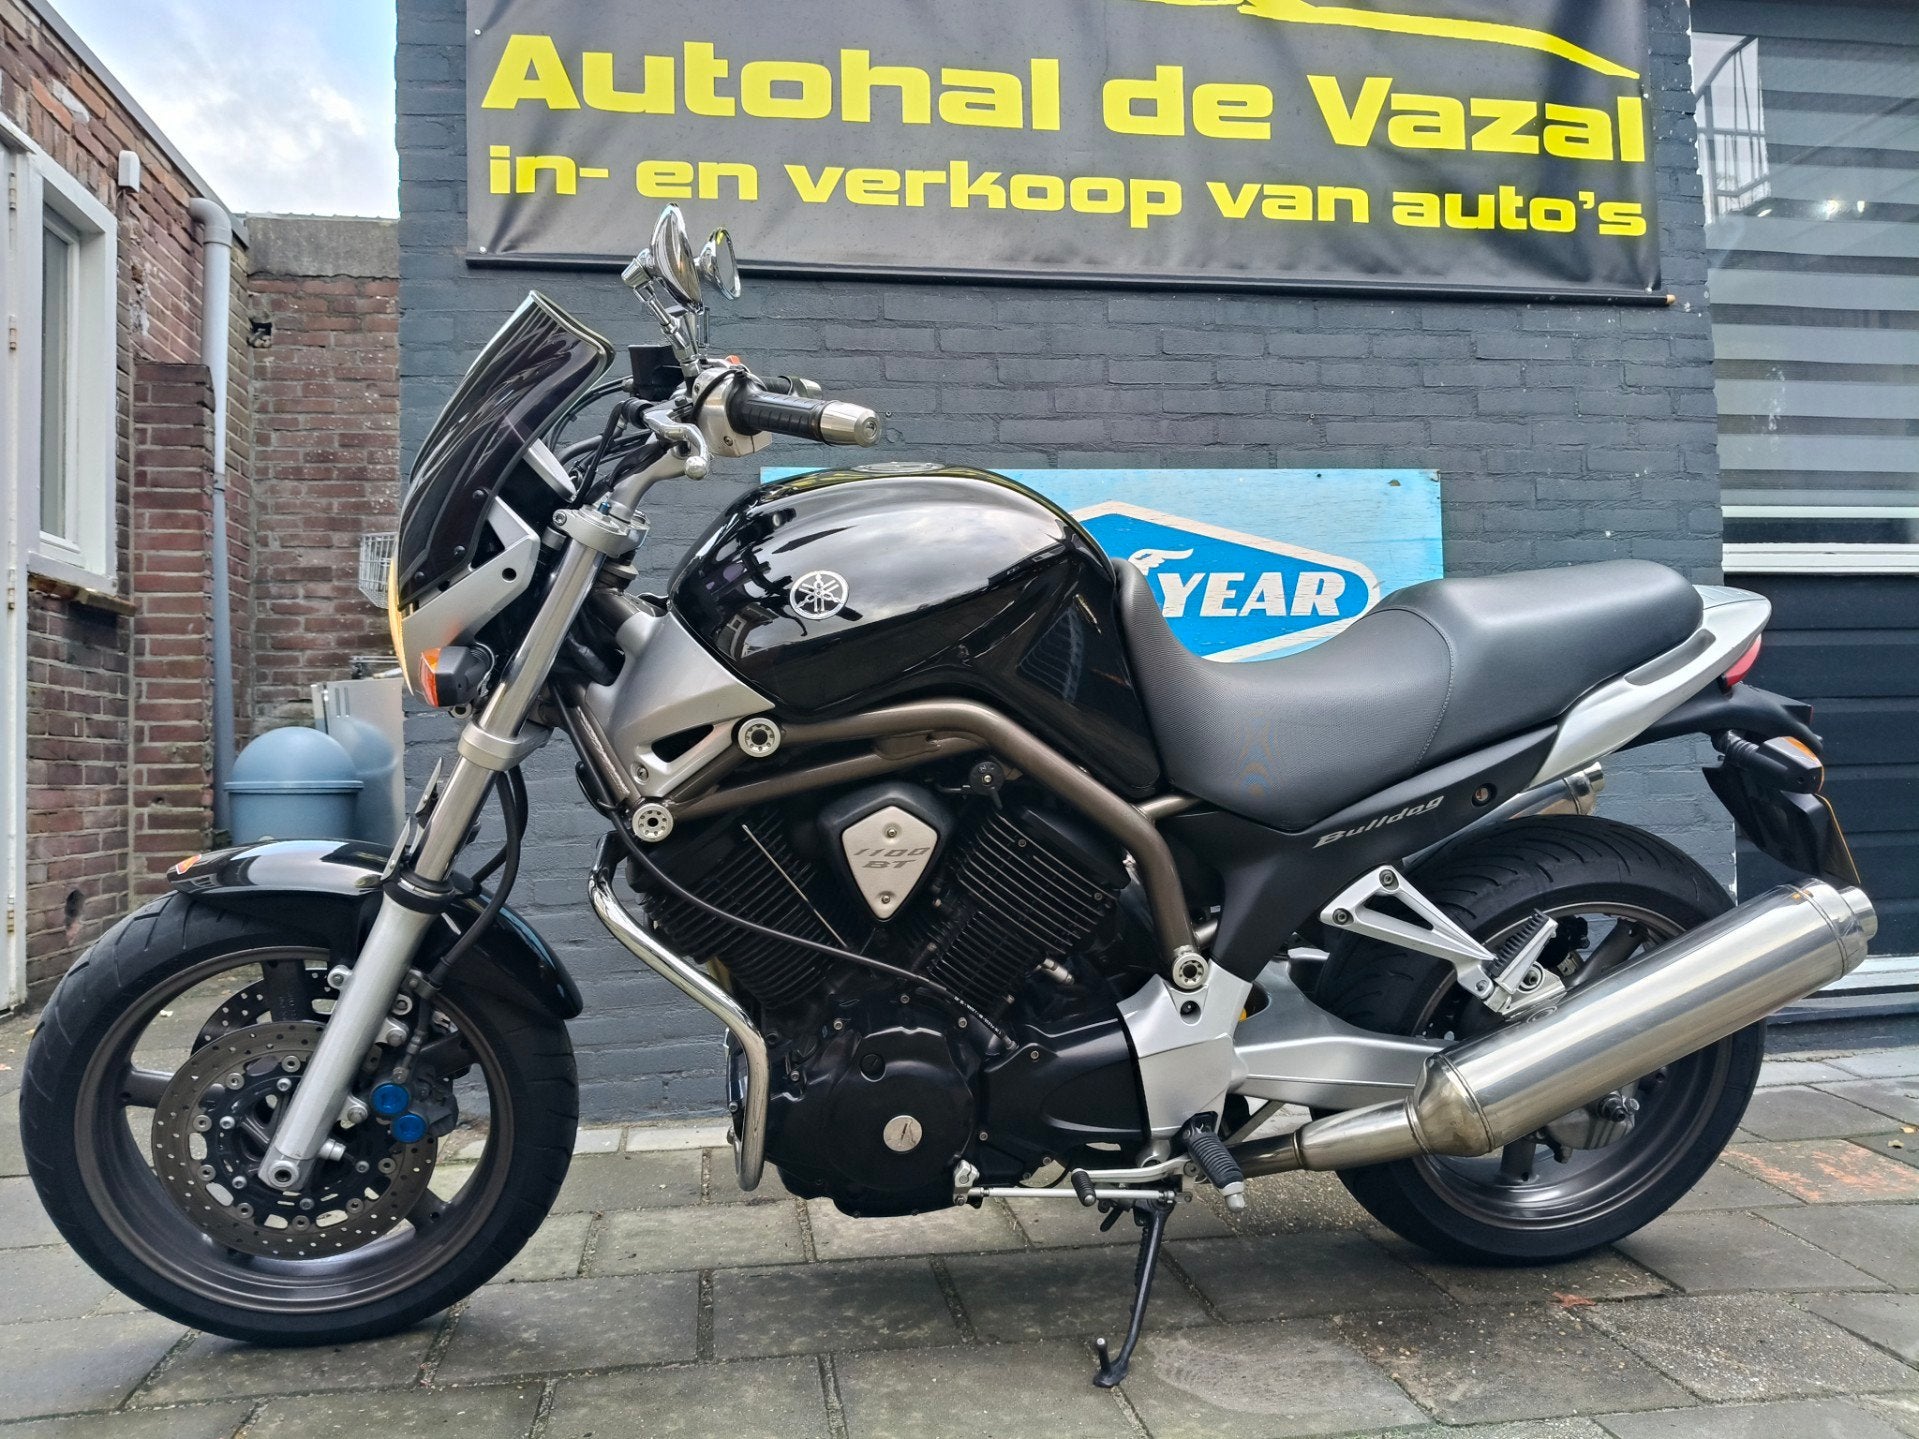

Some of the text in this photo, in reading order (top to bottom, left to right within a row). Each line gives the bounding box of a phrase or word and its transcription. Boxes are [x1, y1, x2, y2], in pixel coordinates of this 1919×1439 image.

[481, 34, 1647, 164] Autohal de Vazal
[489, 145, 1649, 238] in- en verkoop van auto's
[1311, 795, 1445, 850] Bulldog
[853, 846, 931, 857] 1100
[861, 859, 917, 869] BT
